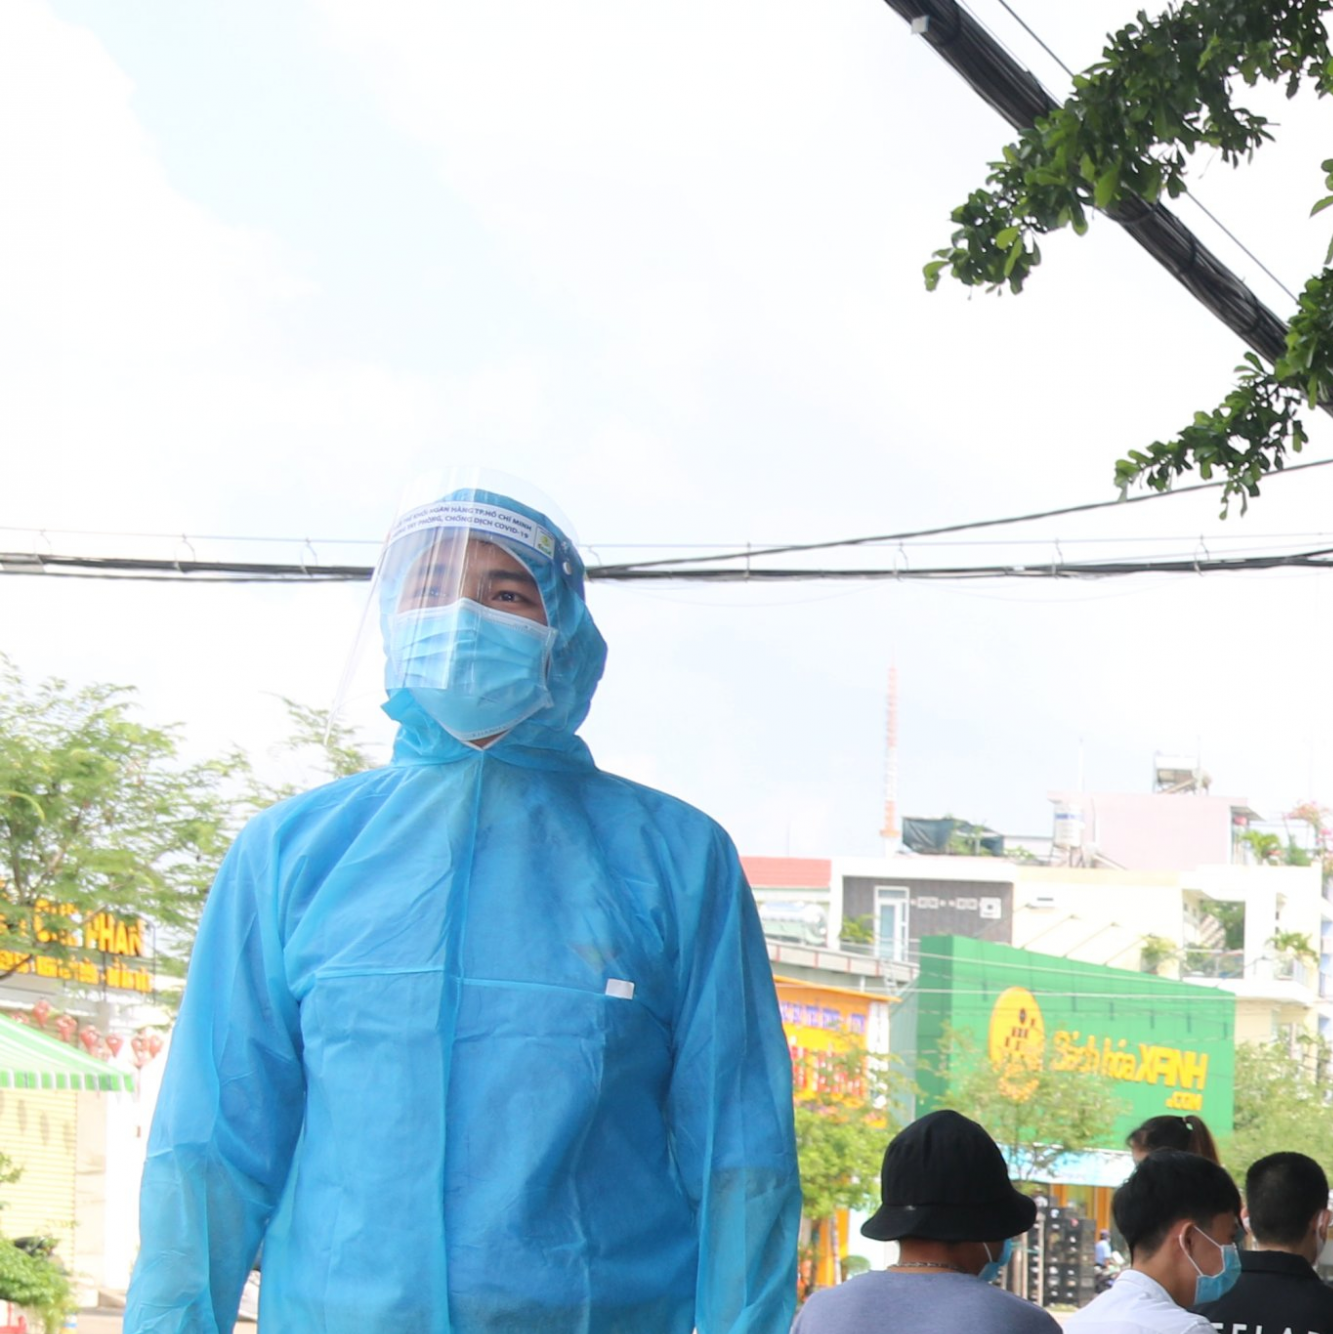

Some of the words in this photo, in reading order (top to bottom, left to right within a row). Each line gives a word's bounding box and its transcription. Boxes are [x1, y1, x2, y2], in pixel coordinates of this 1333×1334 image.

[474, 517, 493, 526] DỊCH
[494, 522, 529, 539] COVID-19
[1137, 1043, 1209, 1090] XANH
